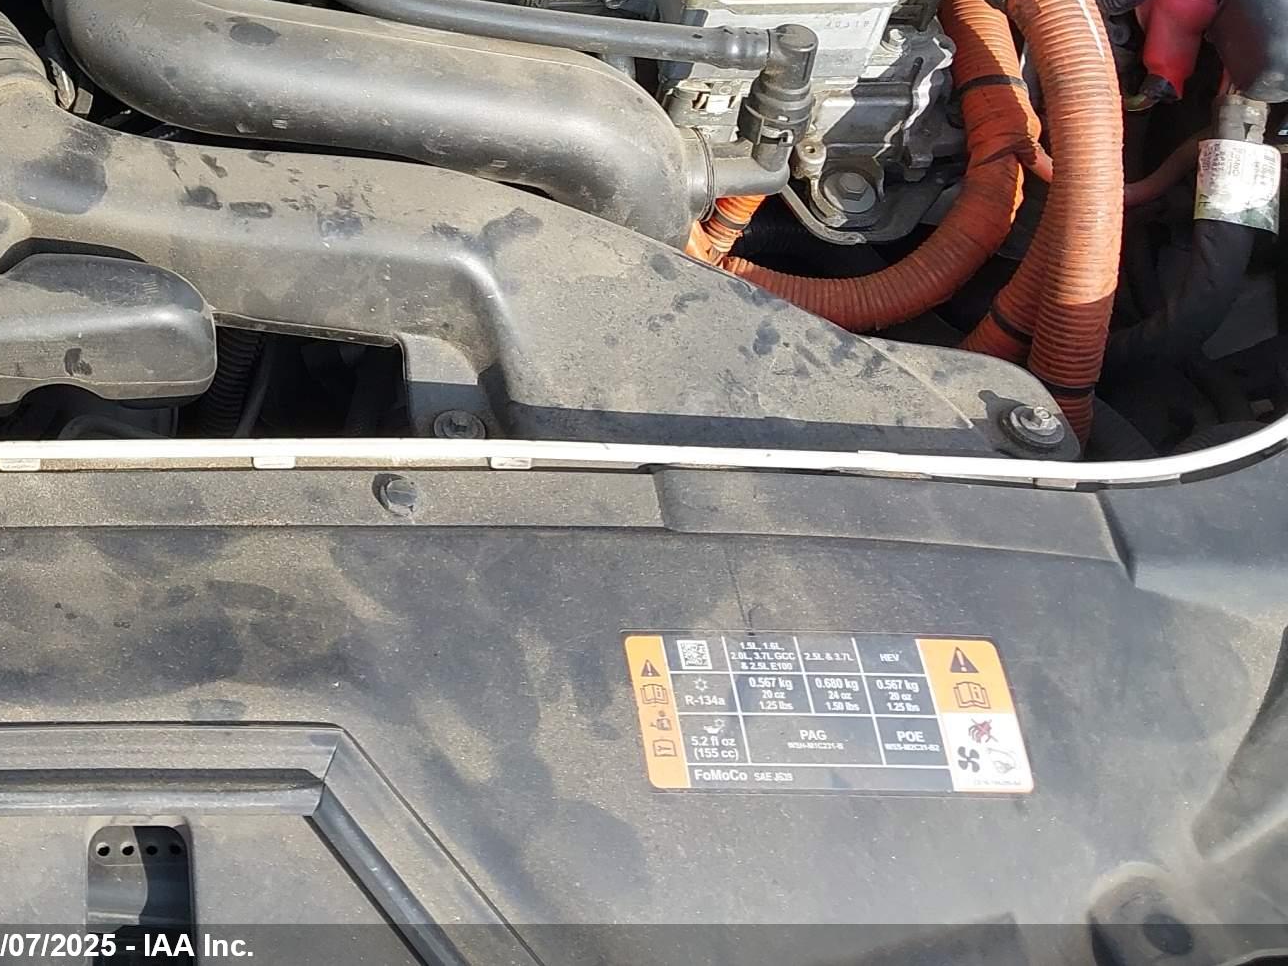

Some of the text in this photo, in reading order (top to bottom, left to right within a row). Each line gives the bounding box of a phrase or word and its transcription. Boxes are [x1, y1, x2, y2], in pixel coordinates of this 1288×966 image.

[879, 653, 900, 662] HEV
[770, 662, 793, 670] E100
[748, 677, 794, 691] 0.567 kg
[814, 678, 859, 691] 0.680 kg
[875, 679, 920, 693] 0.567 kg
[762, 690, 786, 699] 20 oz
[828, 691, 853, 700] 24 oz
[888, 691, 913, 701] 20 oz
[684, 695, 726, 706] R-134a
[759, 701, 794, 710] 1.25 lbs
[825, 701, 860, 711] 1.50 lbs
[886, 702, 921, 712] 1.25 lbs
[691, 735, 736, 746] 5.2 fl oz
[799, 729, 827, 741] PAG
[895, 730, 925, 742] POE
[694, 748, 739, 761] (155 cc)
[694, 769, 748, 781] FoMoCo
[753, 772, 772, 781] SAE
